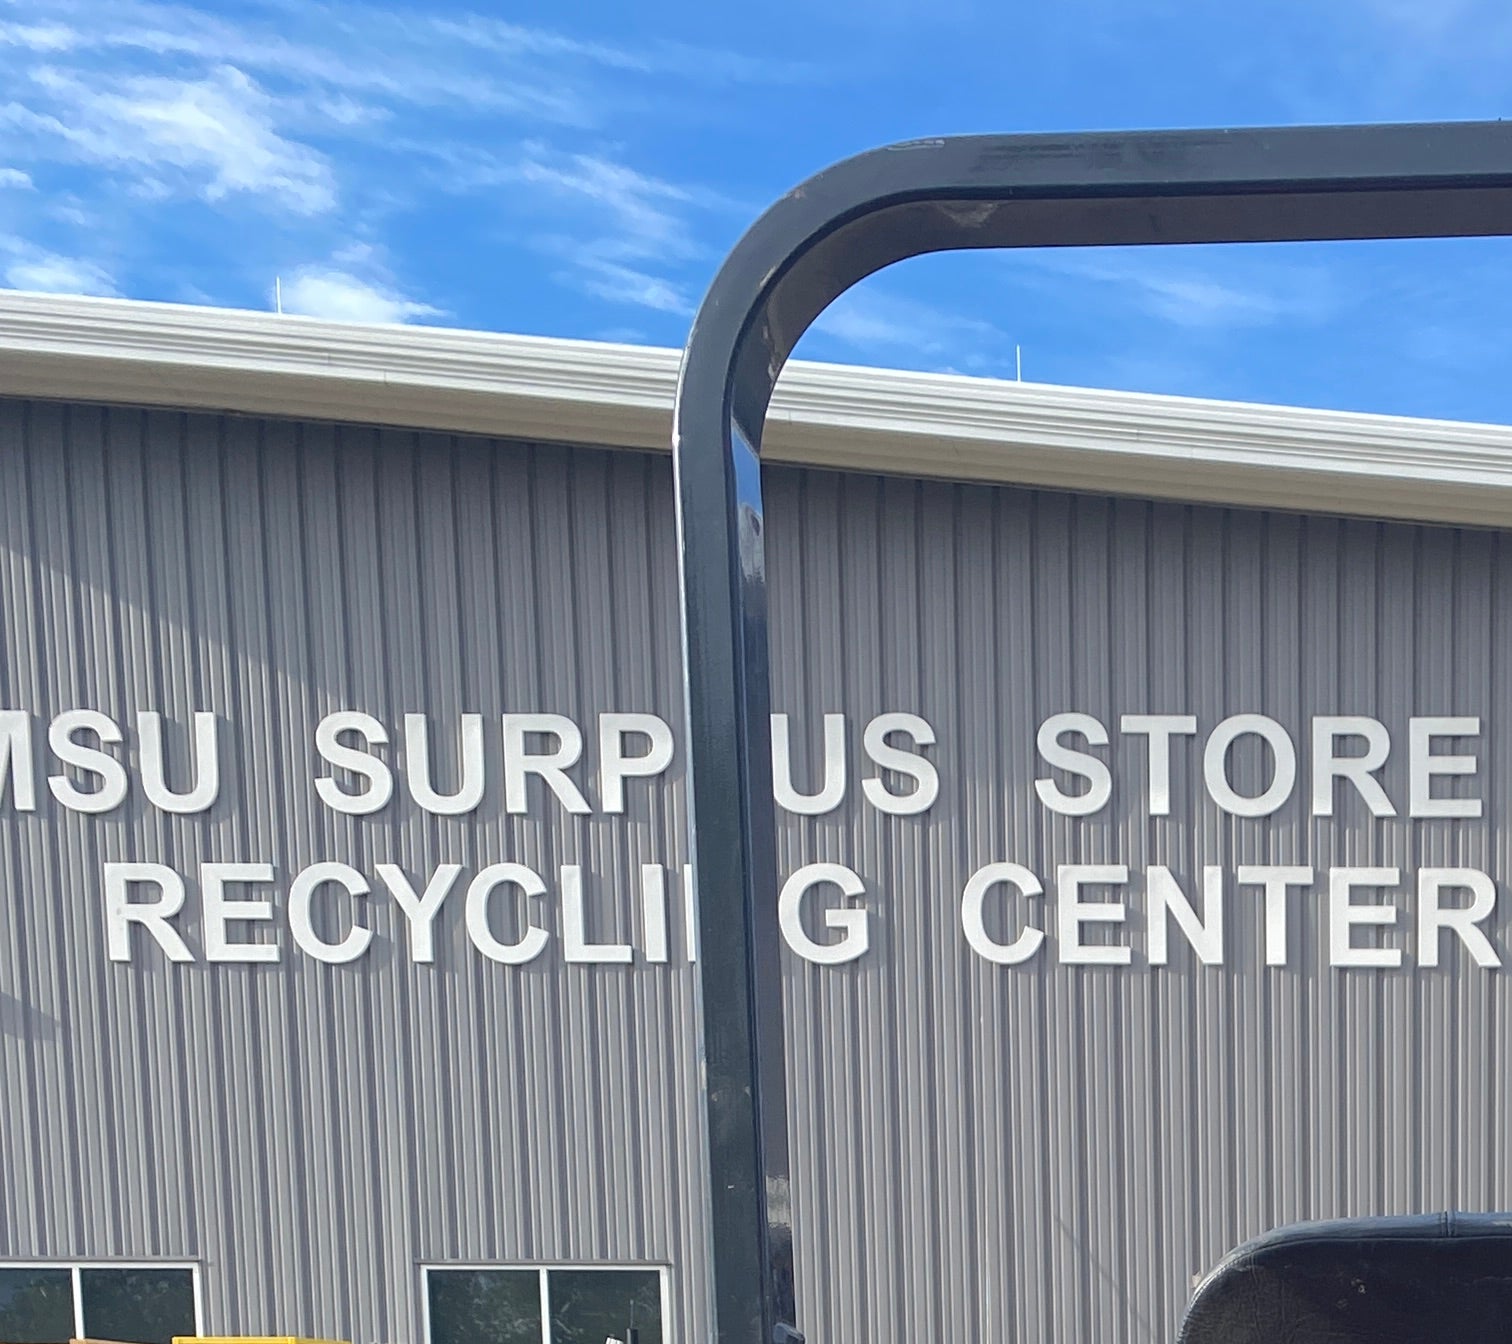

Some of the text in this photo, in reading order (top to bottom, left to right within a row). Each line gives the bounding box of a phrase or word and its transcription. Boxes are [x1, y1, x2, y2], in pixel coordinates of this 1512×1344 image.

[314, 710, 940, 817] SURPUS
[1034, 712, 1484, 819] STORE
[104, 861, 1502, 970] RECYCLIG CENTER
